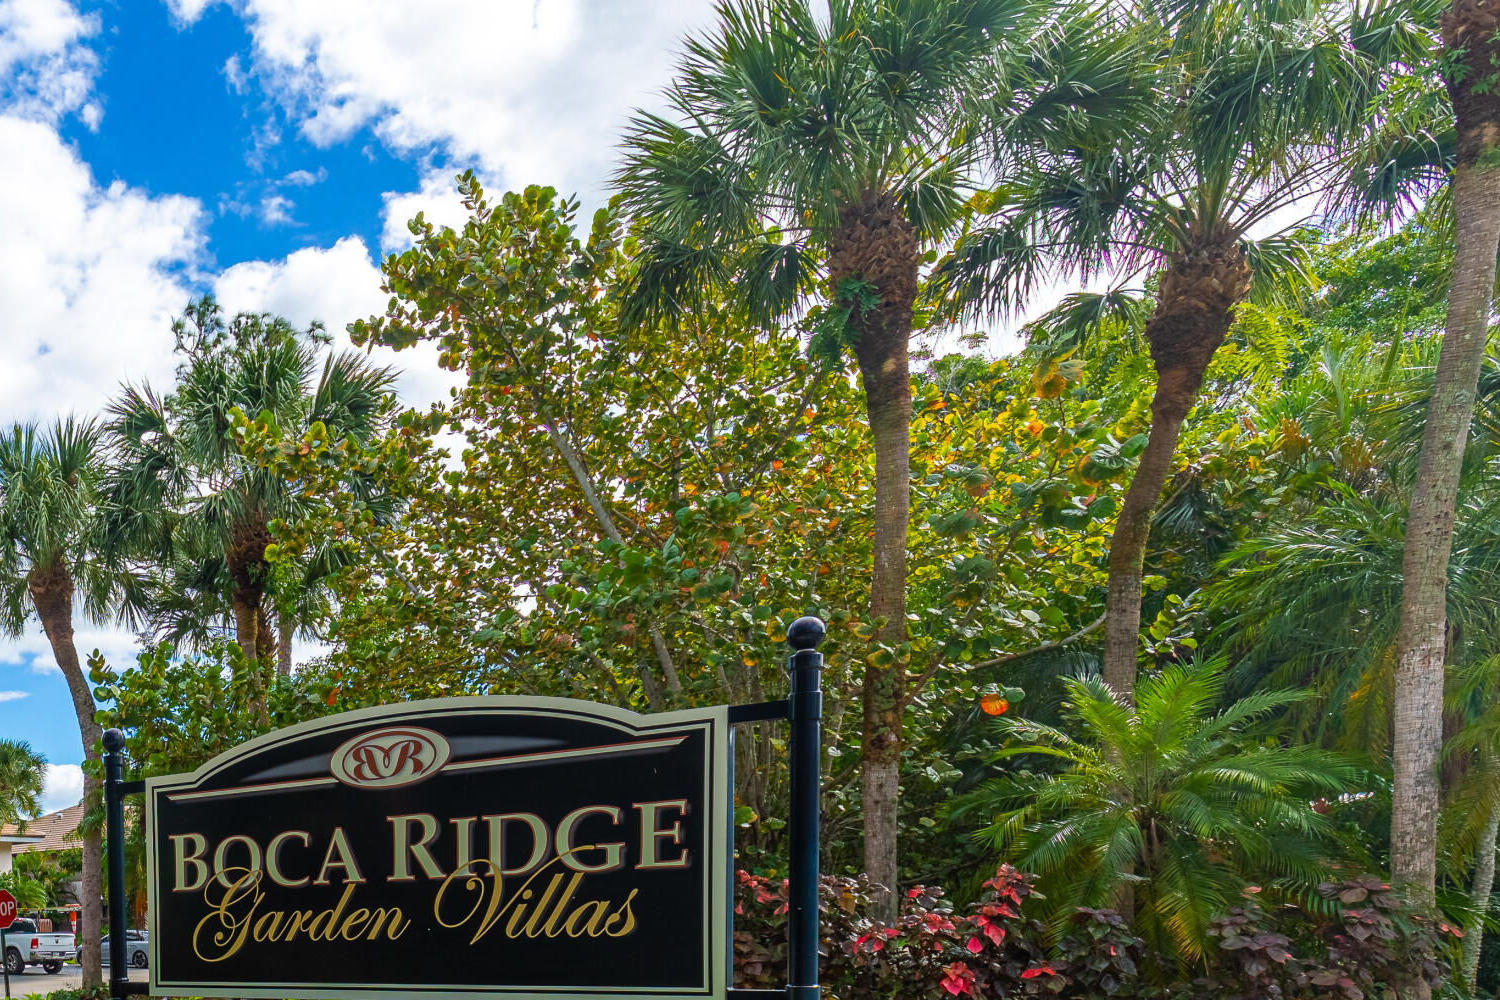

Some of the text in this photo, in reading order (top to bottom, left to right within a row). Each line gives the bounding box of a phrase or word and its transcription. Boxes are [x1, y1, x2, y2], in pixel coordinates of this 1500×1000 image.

[168, 800, 689, 893] BOCA RIDGE
[192, 845, 638, 963] Garden Villas
